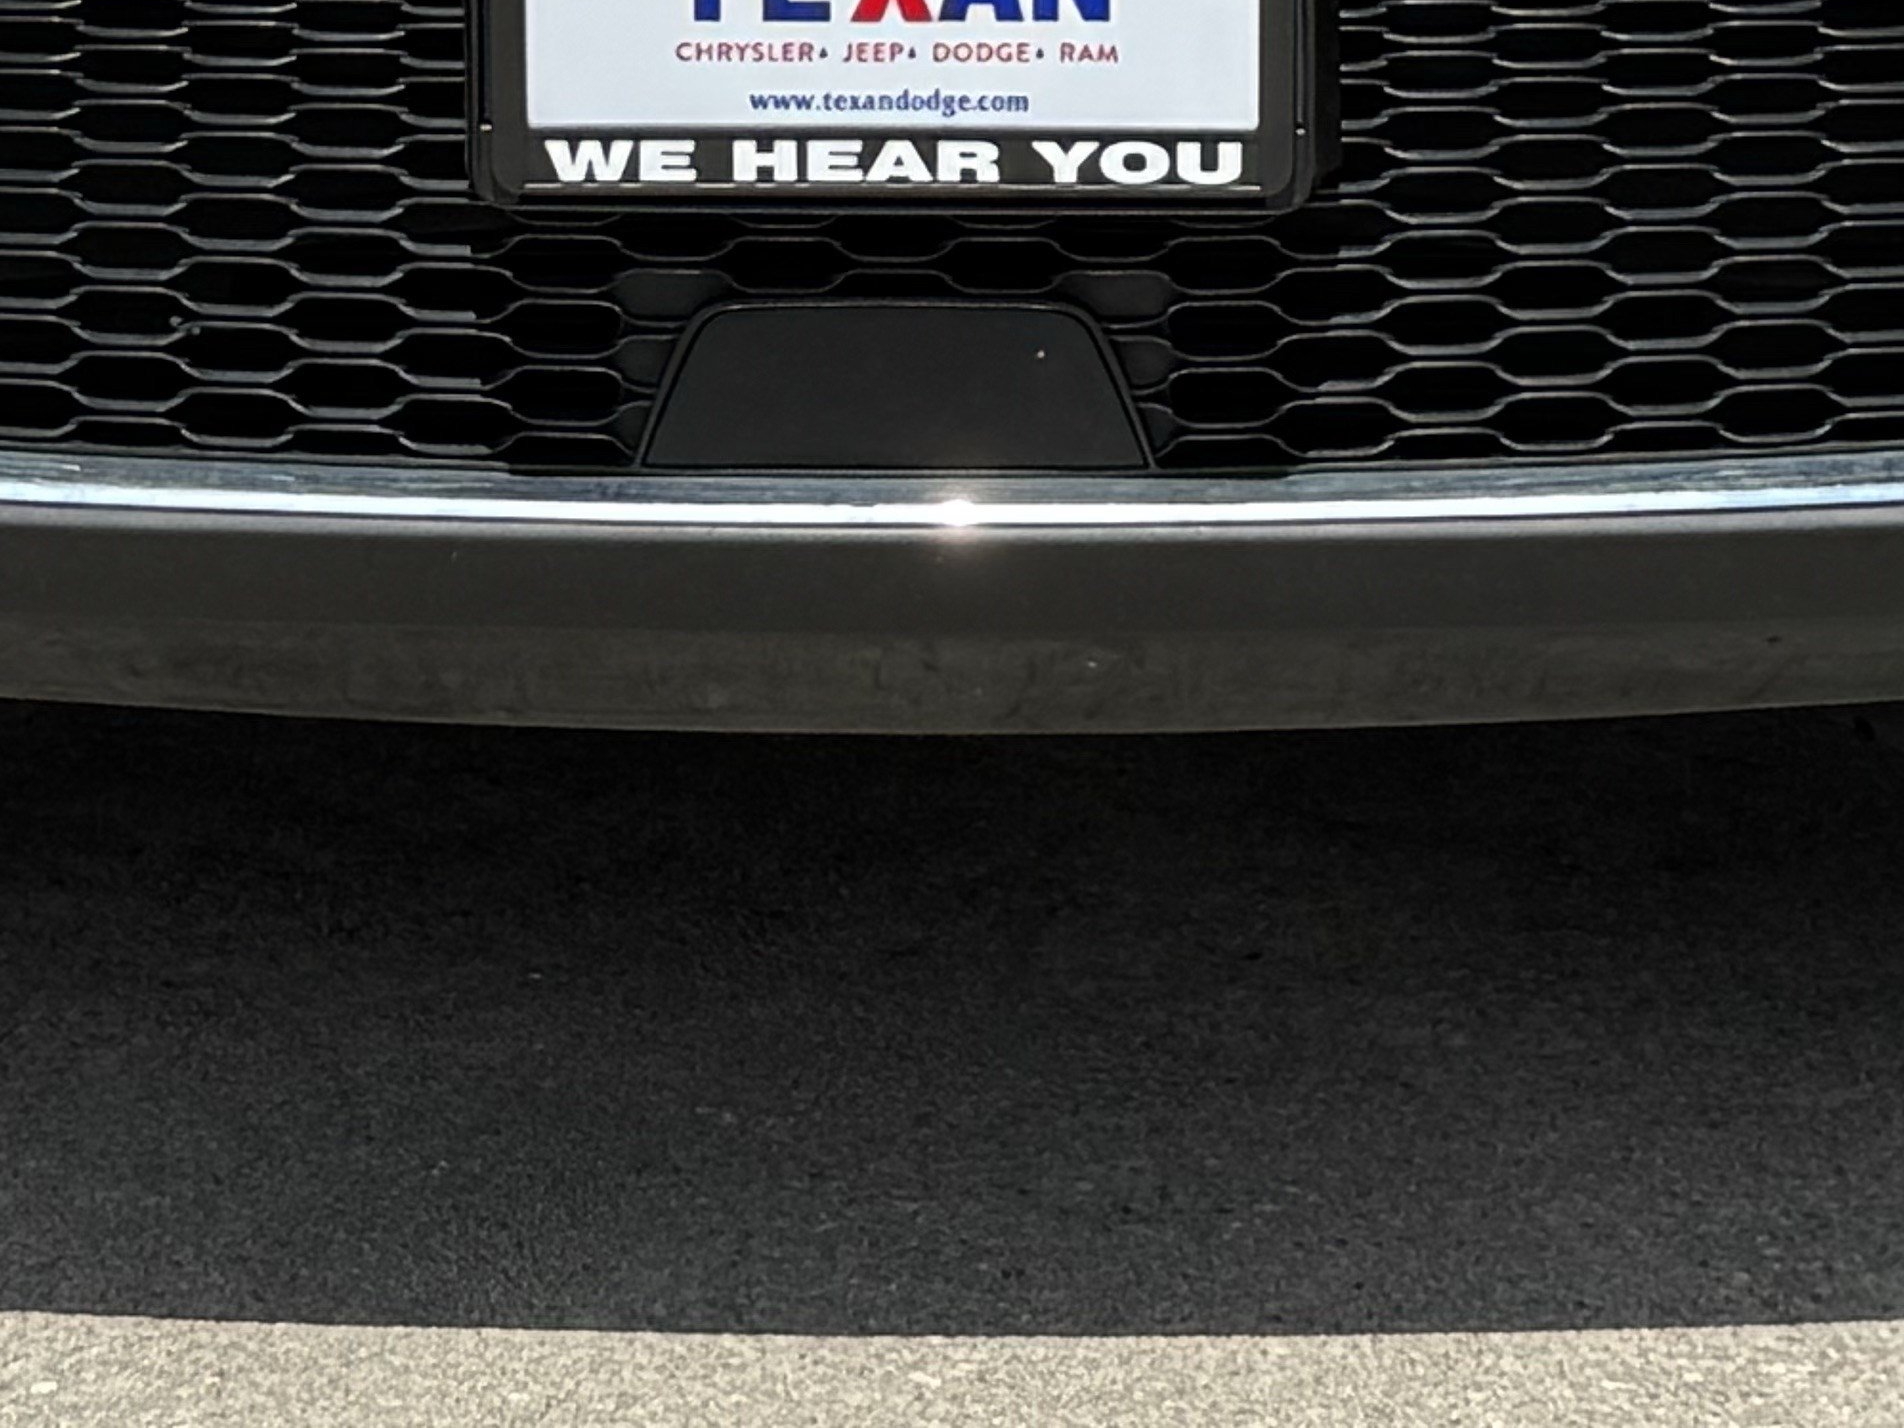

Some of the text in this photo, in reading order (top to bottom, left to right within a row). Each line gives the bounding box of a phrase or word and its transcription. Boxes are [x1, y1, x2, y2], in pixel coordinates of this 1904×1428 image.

[675, 41, 1119, 64] CHRYSLER JEEP DODGE RAM
[748, 89, 1030, 118] www.texandodge.com
[544, 140, 1243, 186] WE HEAR YOU
